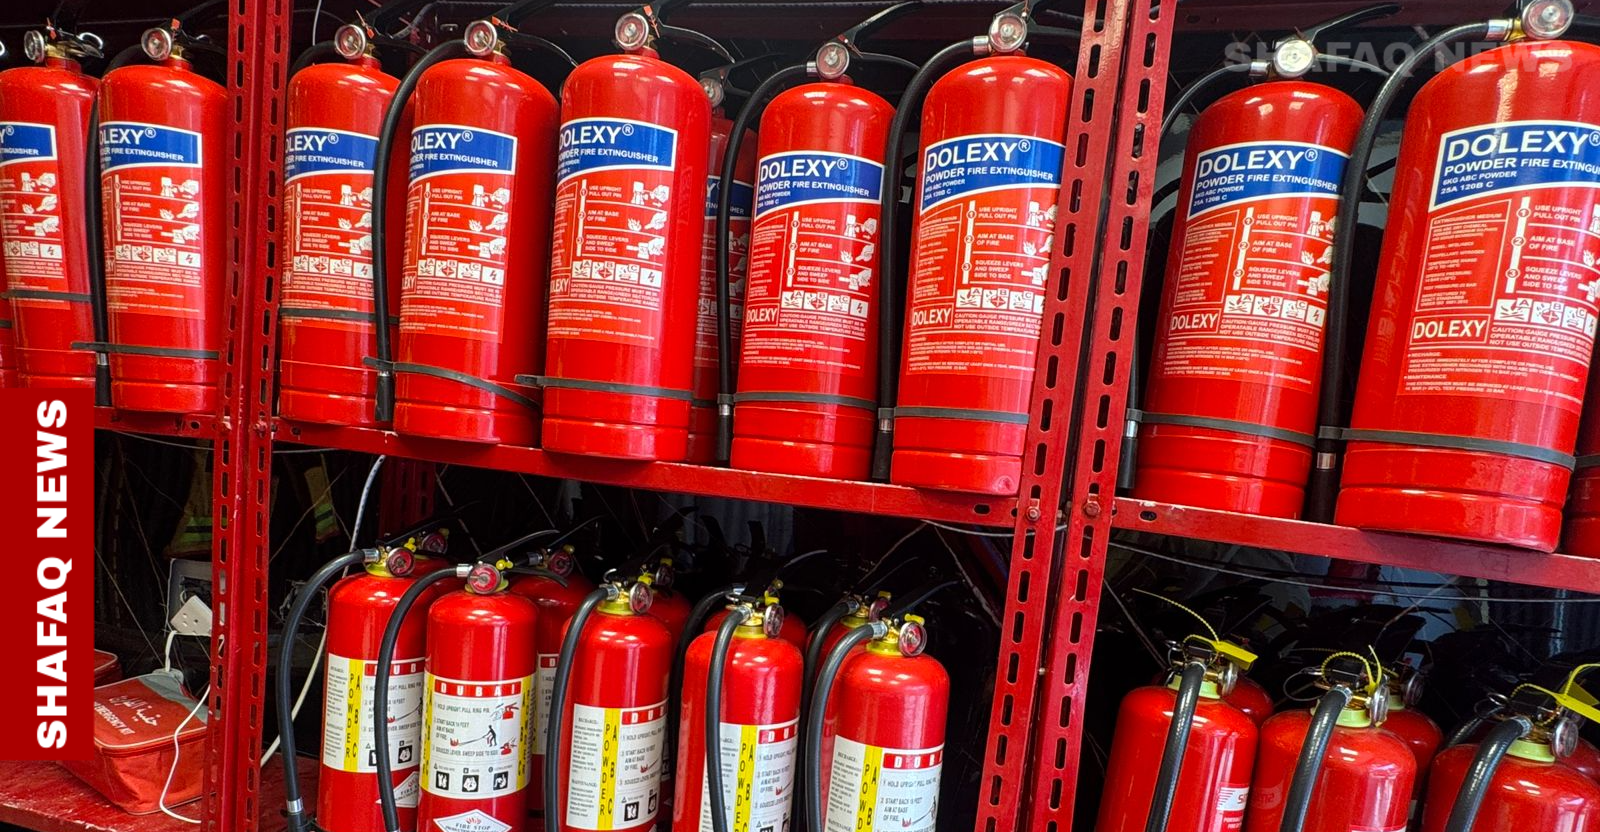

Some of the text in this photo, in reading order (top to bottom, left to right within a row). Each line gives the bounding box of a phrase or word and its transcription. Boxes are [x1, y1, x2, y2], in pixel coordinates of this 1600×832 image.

[308, 155, 365, 168] EXTINGUISHER
[439, 153, 498, 168] EXTINGUISHER
[598, 148, 658, 163] EXTINGUISHER
[1443, 157, 1518, 177] POWDER
[1520, 158, 1550, 168] FIRE
[925, 166, 1054, 185] POWDER FIRE EXTINGUISHER
[1196, 174, 1338, 192] POWDER FIRE EXTINGUISHER
[1442, 171, 1517, 186] 6KG ABC POWDER
[758, 181, 790, 194] POWDER
[811, 181, 869, 197] EXTINGUISHER
[1217, 185, 1245, 194] POWDER
[1440, 186, 1458, 195] 25A
[1460, 182, 1484, 191] 120B
[1551, 206, 1582, 215] UPRIGHT
[1275, 241, 1293, 249] BASE
[1541, 244, 1559, 252] FIRE
[1556, 238, 1576, 247] BASE
[1525, 266, 1558, 275] SQUEEZE
[747, 307, 778, 323] DOLEXY
[913, 307, 951, 326] DOLEXY
[1171, 313, 1218, 331] DOLEXY
[1413, 319, 1487, 339] DOLEXY
[441, 683, 515, 697] DUBAI
